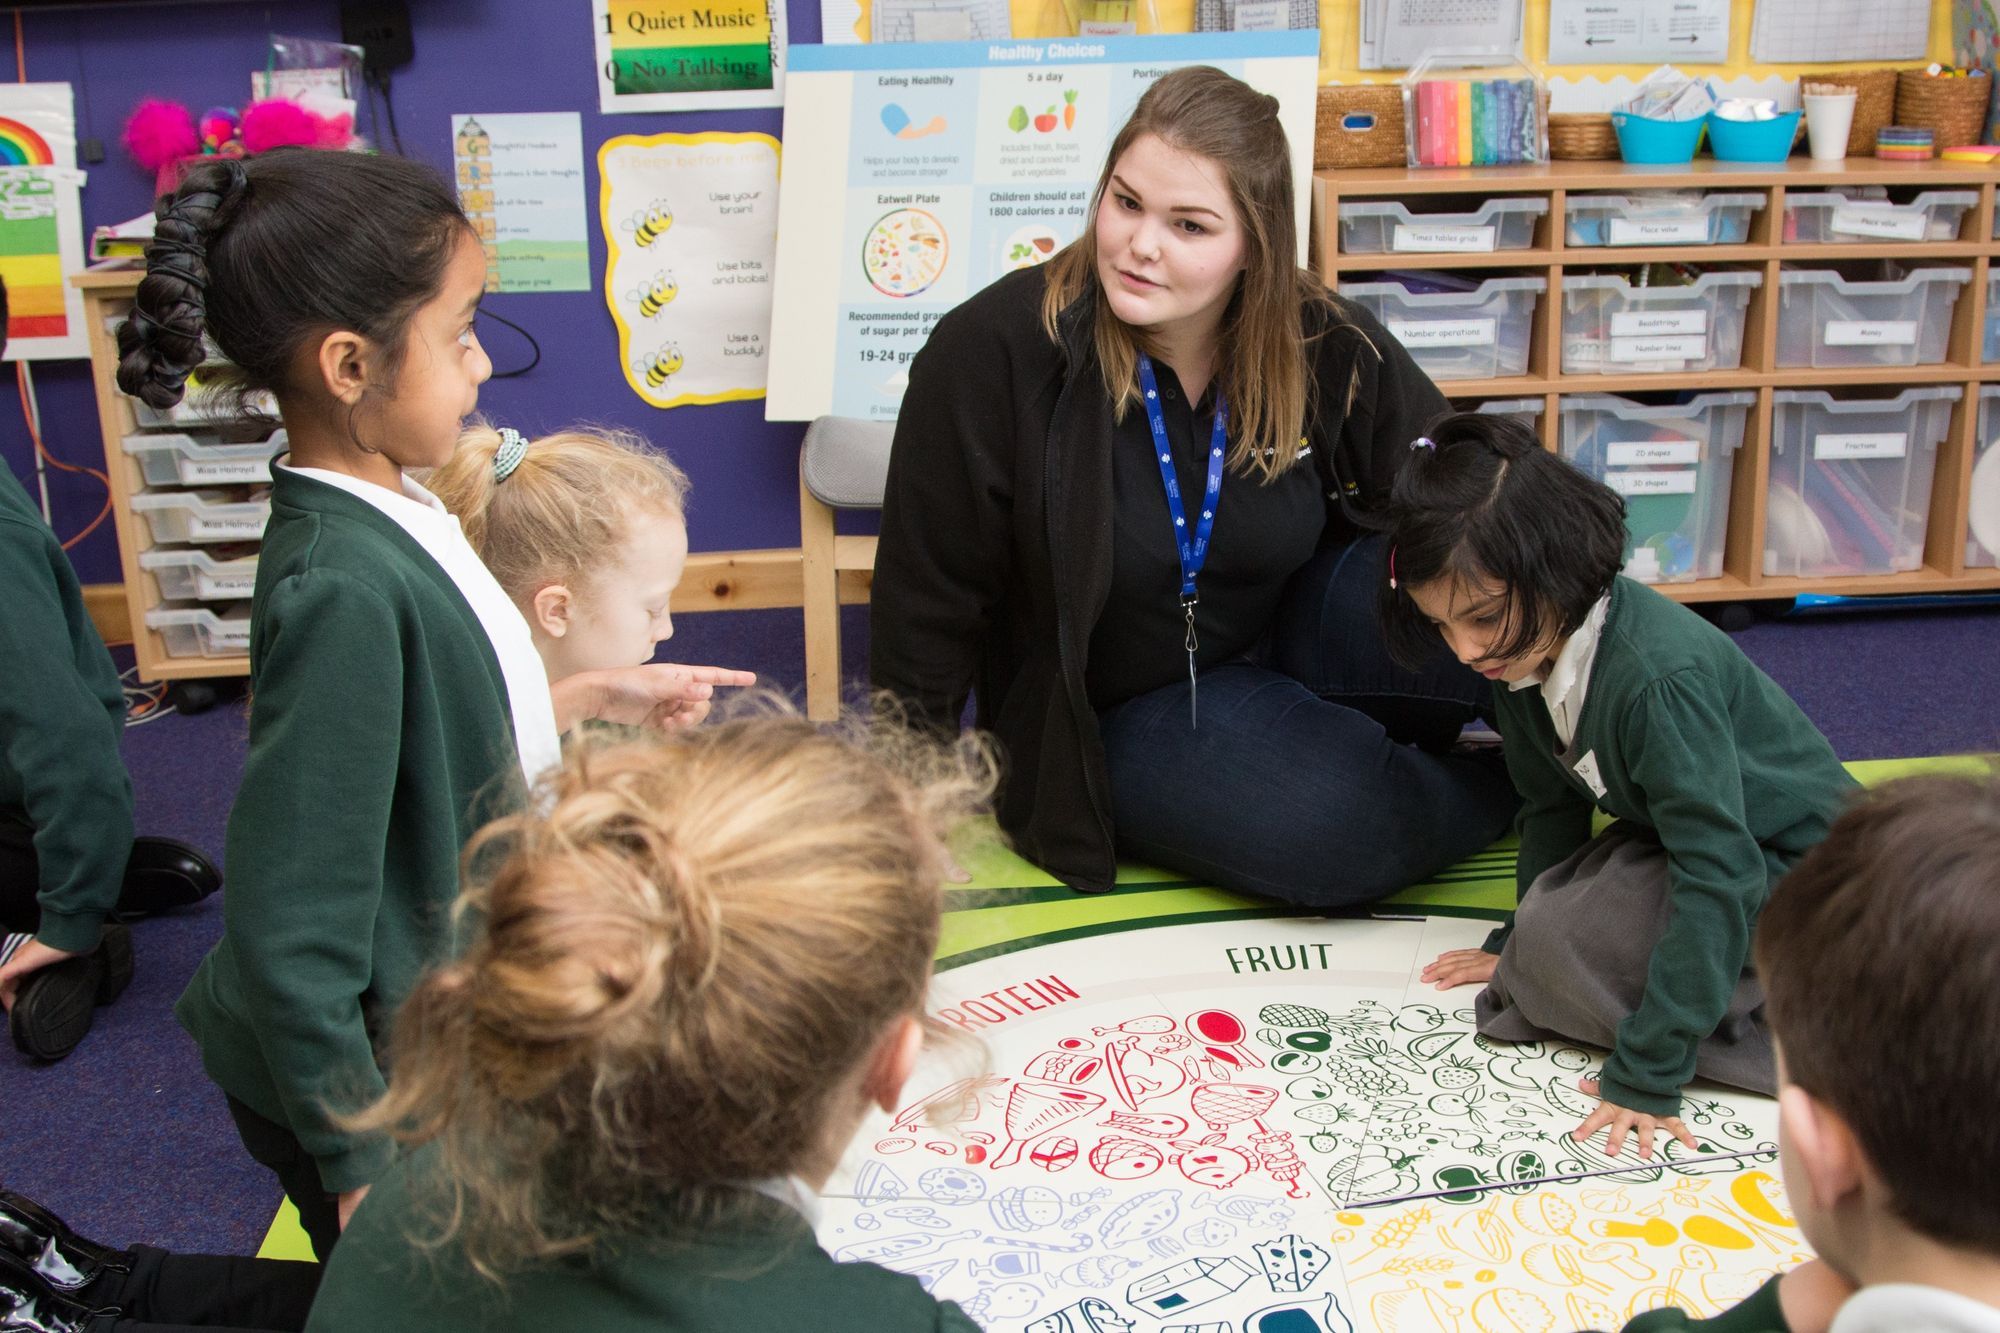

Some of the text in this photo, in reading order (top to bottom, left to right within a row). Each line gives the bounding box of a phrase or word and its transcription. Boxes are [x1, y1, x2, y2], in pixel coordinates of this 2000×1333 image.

[602, 8, 755, 34] 1 Quiet Music
[988, 43, 1104, 61] Healthy Choices
[605, 57, 758, 81] 0 No Talking
[878, 75, 954, 87] Eating Healthily
[1027, 72, 1033, 82] 5
[1046, 72, 1063, 82] day
[1001, 143, 1031, 152] Includes
[863, 156, 884, 166] Helps
[886, 157, 901, 166] your
[902, 155, 920, 165] body
[931, 155, 959, 165] develop
[1000, 155, 1018, 165] dried
[1021, 155, 1034, 164] and
[872, 167, 948, 178] and become stronger
[1011, 167, 1066, 178] and vegetables
[709, 191, 760, 206] Use your
[877, 194, 940, 204] Eatwell Plate
[990, 191, 1085, 202] Children should eat
[720, 204, 753, 214] brain!
[989, 207, 1013, 216] 1800
[1015, 206, 1055, 215] calories
[1067, 206, 1085, 217] day
[1860, 217, 1879, 226] Place
[1640, 226, 1659, 234] Place
[1412, 233, 1478, 244] Times tables grids
[717, 260, 762, 271] Use bits
[712, 273, 769, 285] and bobs!
[849, 312, 920, 321] Recommended
[1638, 319, 1680, 327] Beadstrings
[860, 327, 870, 335] of
[873, 328, 900, 337] sugar
[903, 328, 918, 337] per
[1404, 328, 1480, 338] Number operations
[1860, 329, 1882, 338] Money
[727, 333, 759, 343] Use a
[724, 345, 764, 357] buddy!
[860, 350, 895, 361] 19-24
[1647, 449, 1670, 457] shapes
[196, 466, 217, 474] Miss
[1645, 479, 1668, 488] shapes
[202, 520, 223, 528] Miss
[1225, 943, 1333, 974] FRUIT
[930, 975, 1081, 1034] ROTEIN
